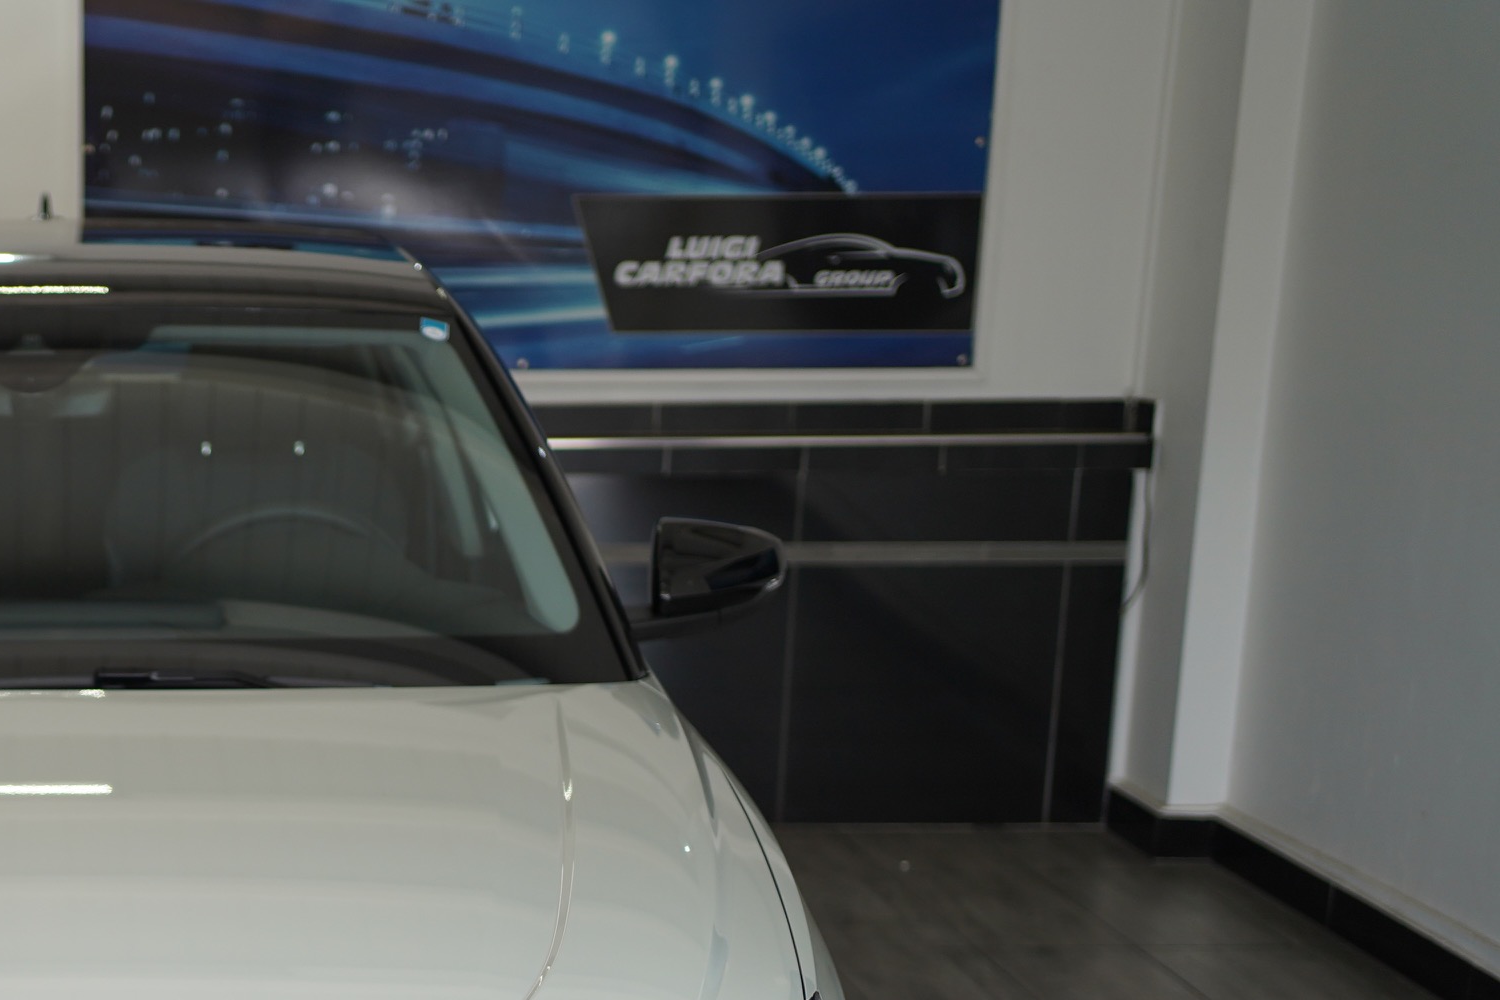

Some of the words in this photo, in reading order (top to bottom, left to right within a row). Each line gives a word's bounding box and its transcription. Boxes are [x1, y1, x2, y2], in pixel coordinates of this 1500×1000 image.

[665, 235, 761, 260] LUIGI
[614, 260, 785, 287] CARFORA
[814, 269, 895, 287] GROUP
